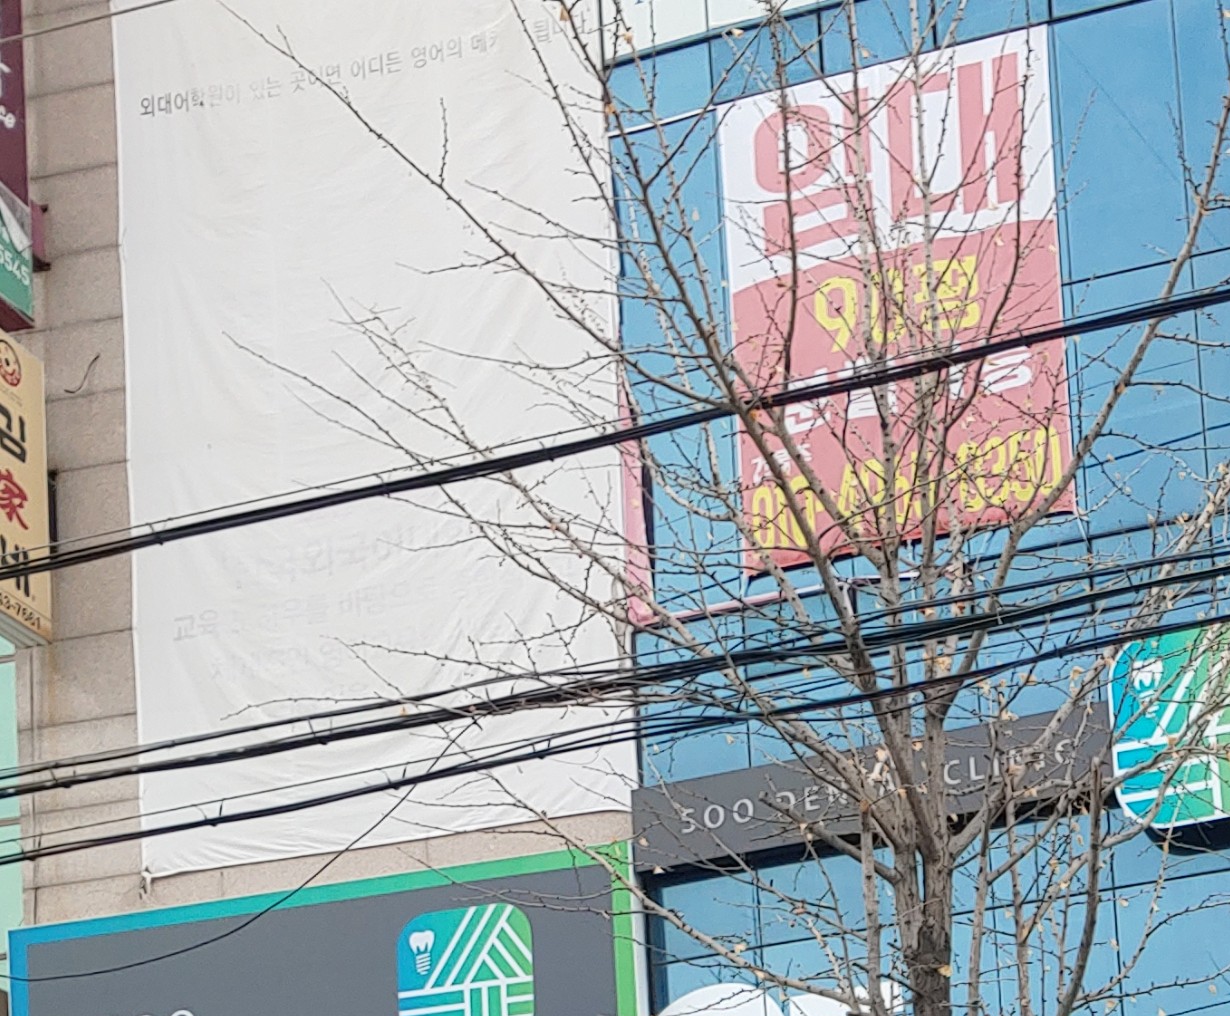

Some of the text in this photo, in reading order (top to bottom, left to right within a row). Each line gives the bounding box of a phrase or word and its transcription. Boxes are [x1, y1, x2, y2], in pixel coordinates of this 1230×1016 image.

[349, 49, 403, 80] 어디든
[411, 35, 463, 69] 영어의
[754, 52, 1022, 257] 임대
[680, 798, 754, 834] SOO
